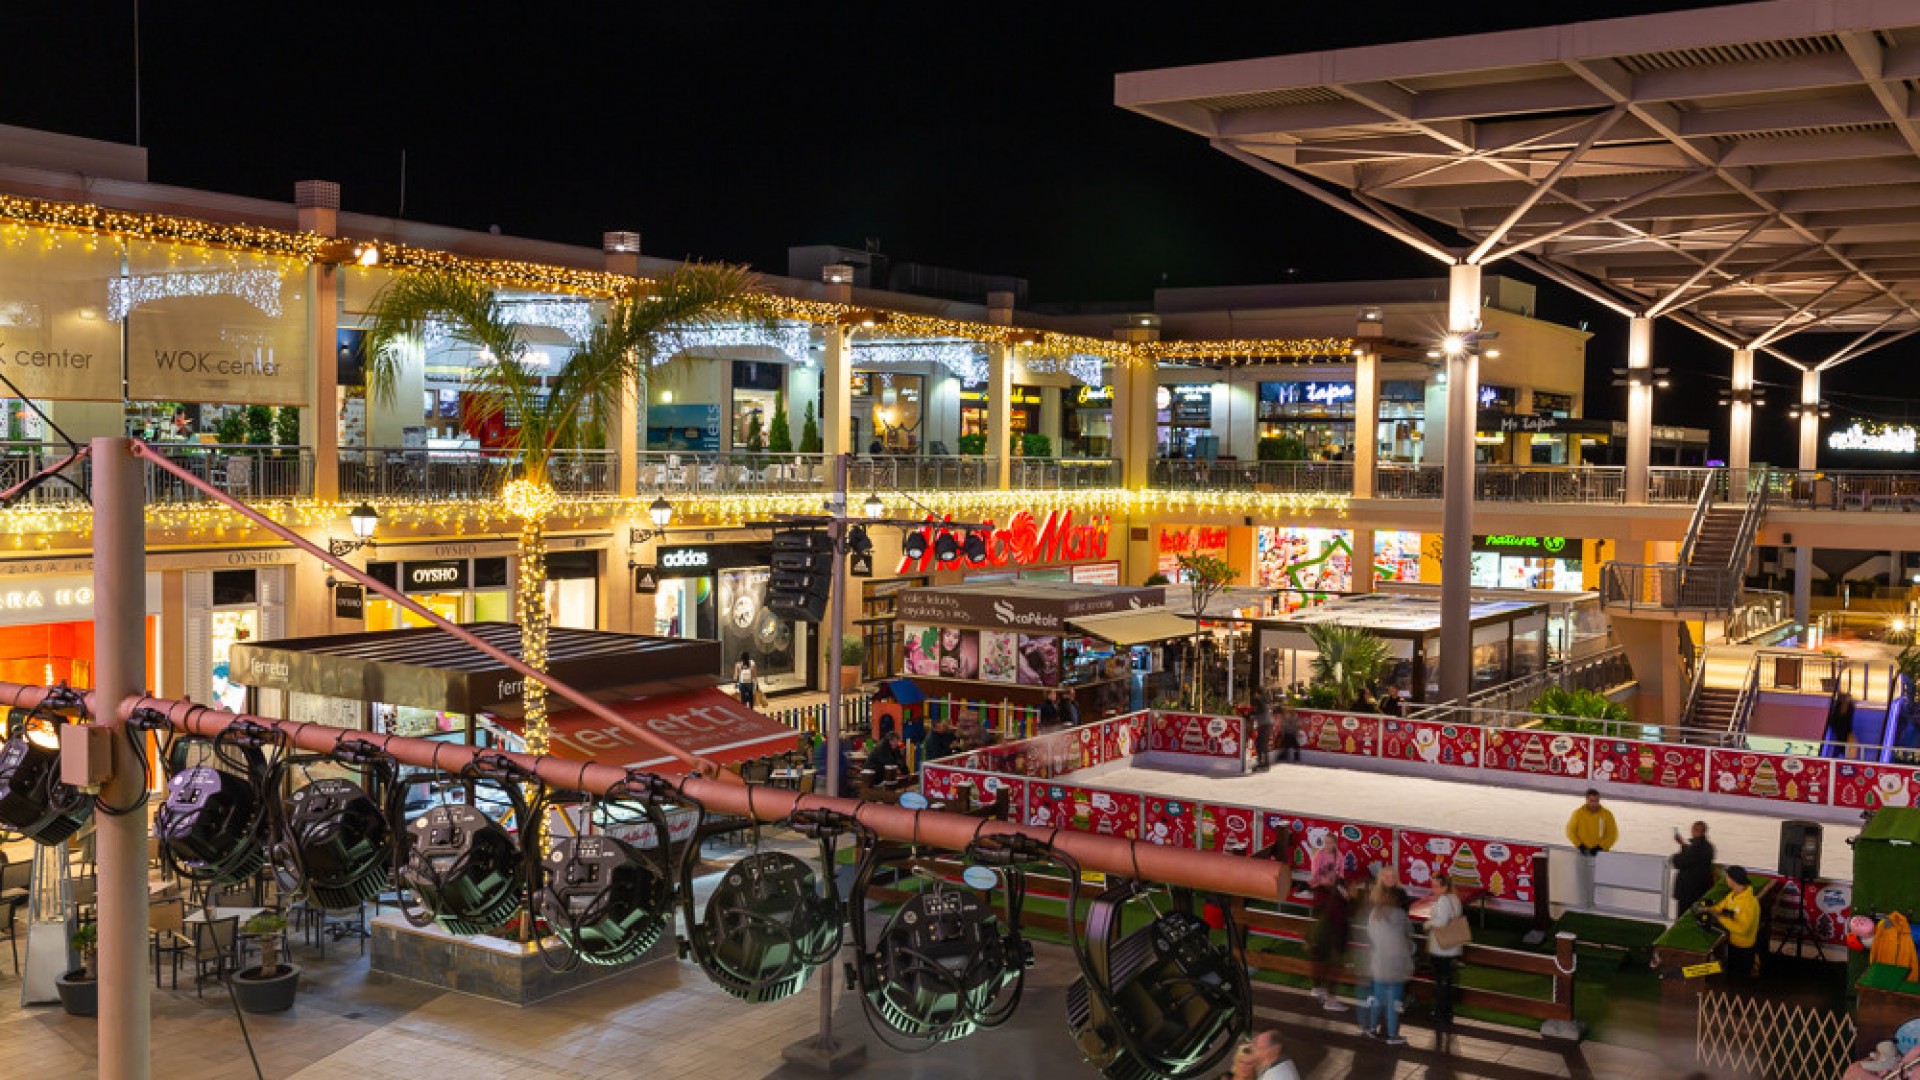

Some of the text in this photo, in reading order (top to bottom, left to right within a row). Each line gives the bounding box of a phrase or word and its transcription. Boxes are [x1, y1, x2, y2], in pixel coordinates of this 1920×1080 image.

[15, 349, 93, 369] center
[154, 349, 281, 377] WOK center
[227, 551, 281, 564] OYSHO
[662, 549, 709, 567] adidas
[8, 561, 94, 574] ZARA HO
[412, 566, 459, 583] OYSHO
[0, 586, 92, 609] RA HO
[549, 704, 746, 758] feretti
